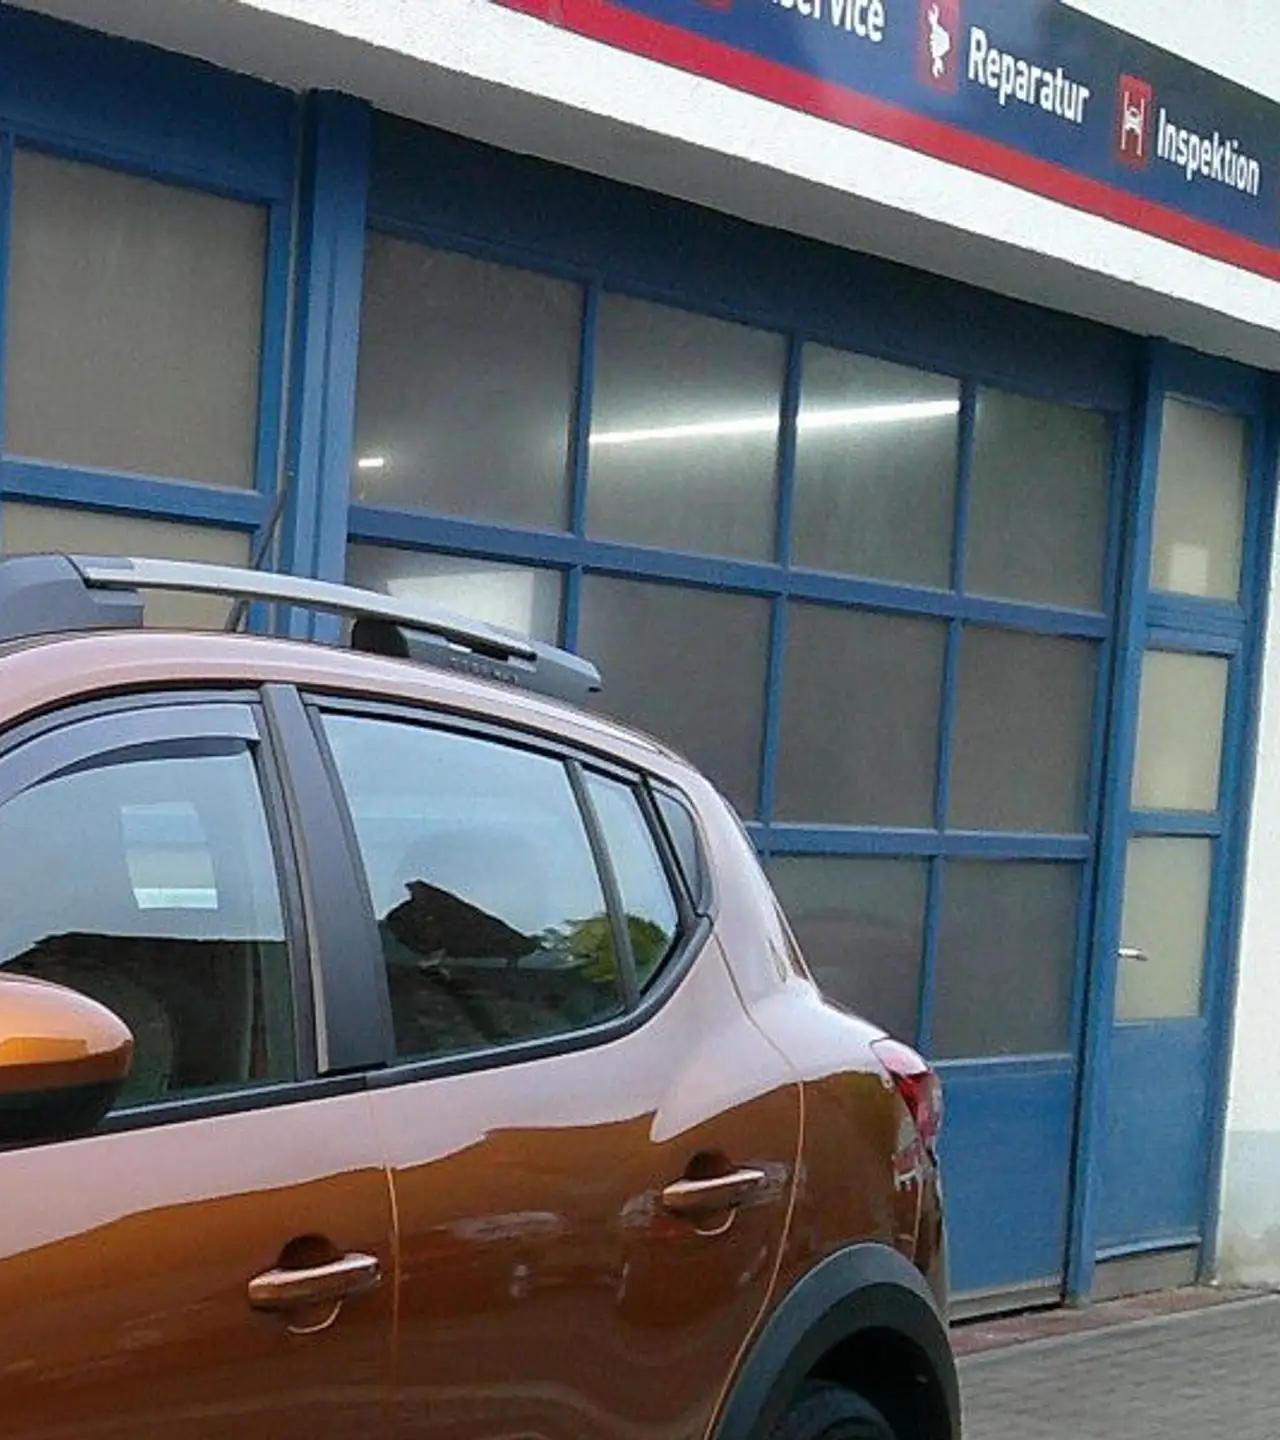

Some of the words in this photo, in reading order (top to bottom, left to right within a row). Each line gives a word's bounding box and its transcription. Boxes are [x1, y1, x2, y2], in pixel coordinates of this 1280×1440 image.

[771, 0, 885, 42] vice
[967, 26, 1089, 124] Reparatur
[1157, 107, 1260, 197] Inspektion
